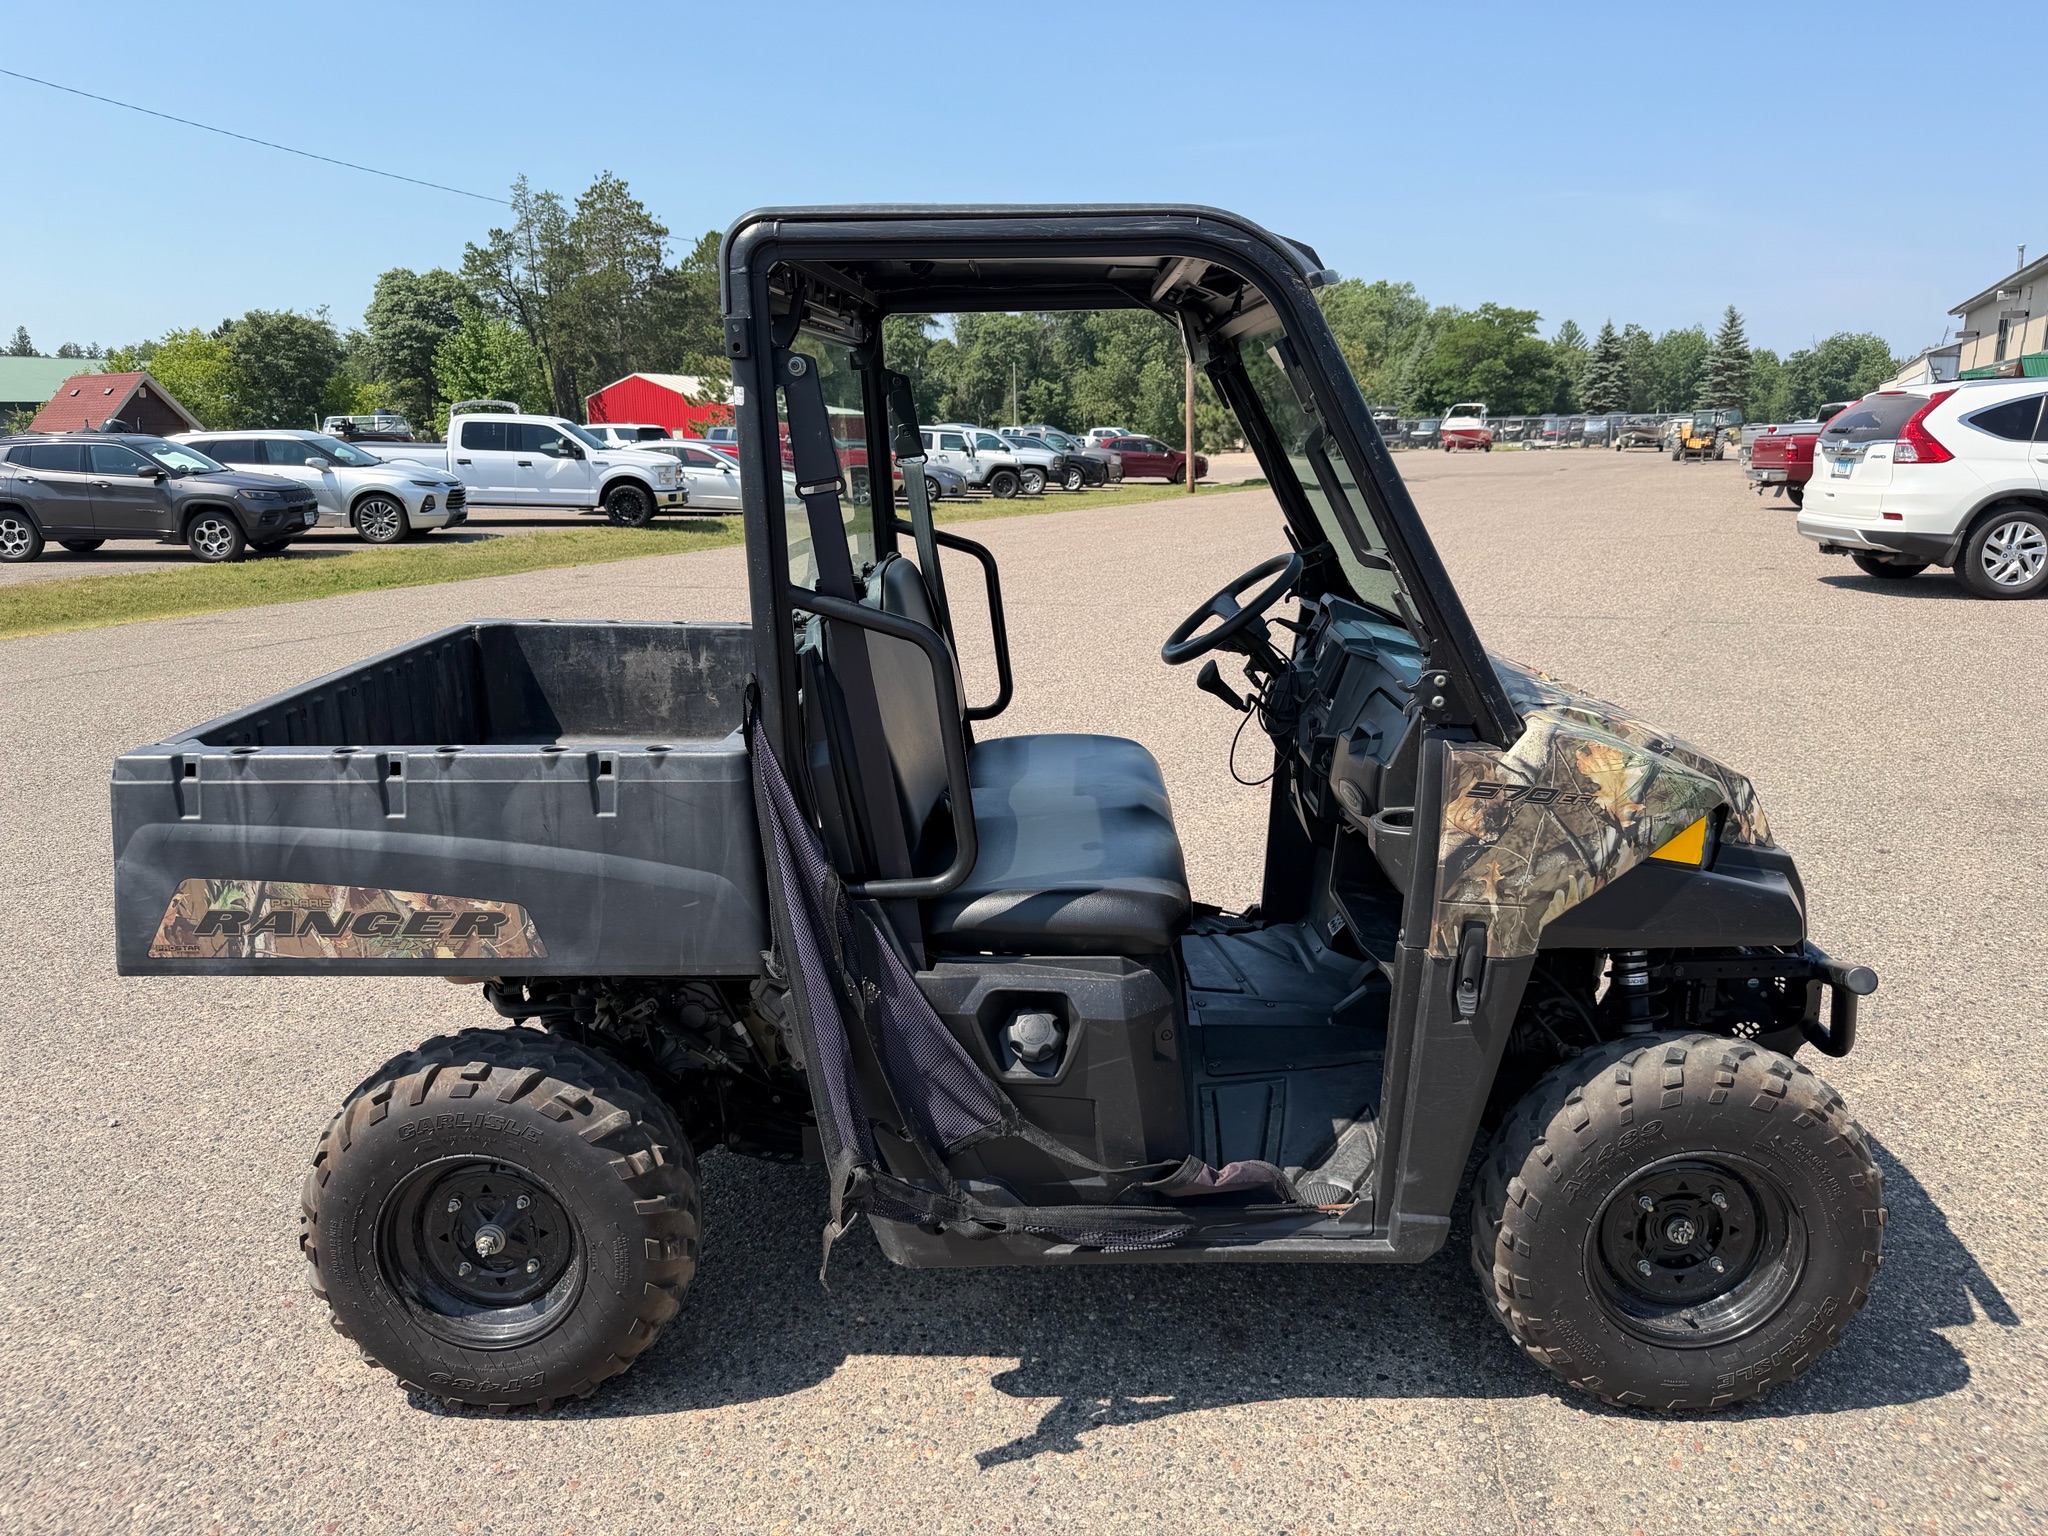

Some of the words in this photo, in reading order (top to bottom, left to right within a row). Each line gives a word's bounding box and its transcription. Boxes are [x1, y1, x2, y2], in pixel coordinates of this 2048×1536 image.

[1466, 781, 1561, 804] 570
[1556, 793, 1599, 806] EFI
[270, 898, 332, 908] POLARIS
[193, 909, 511, 938] RANGER
[398, 1113, 544, 1143] CARLISLE
[1717, 1296, 1838, 1389] CARLISLE
